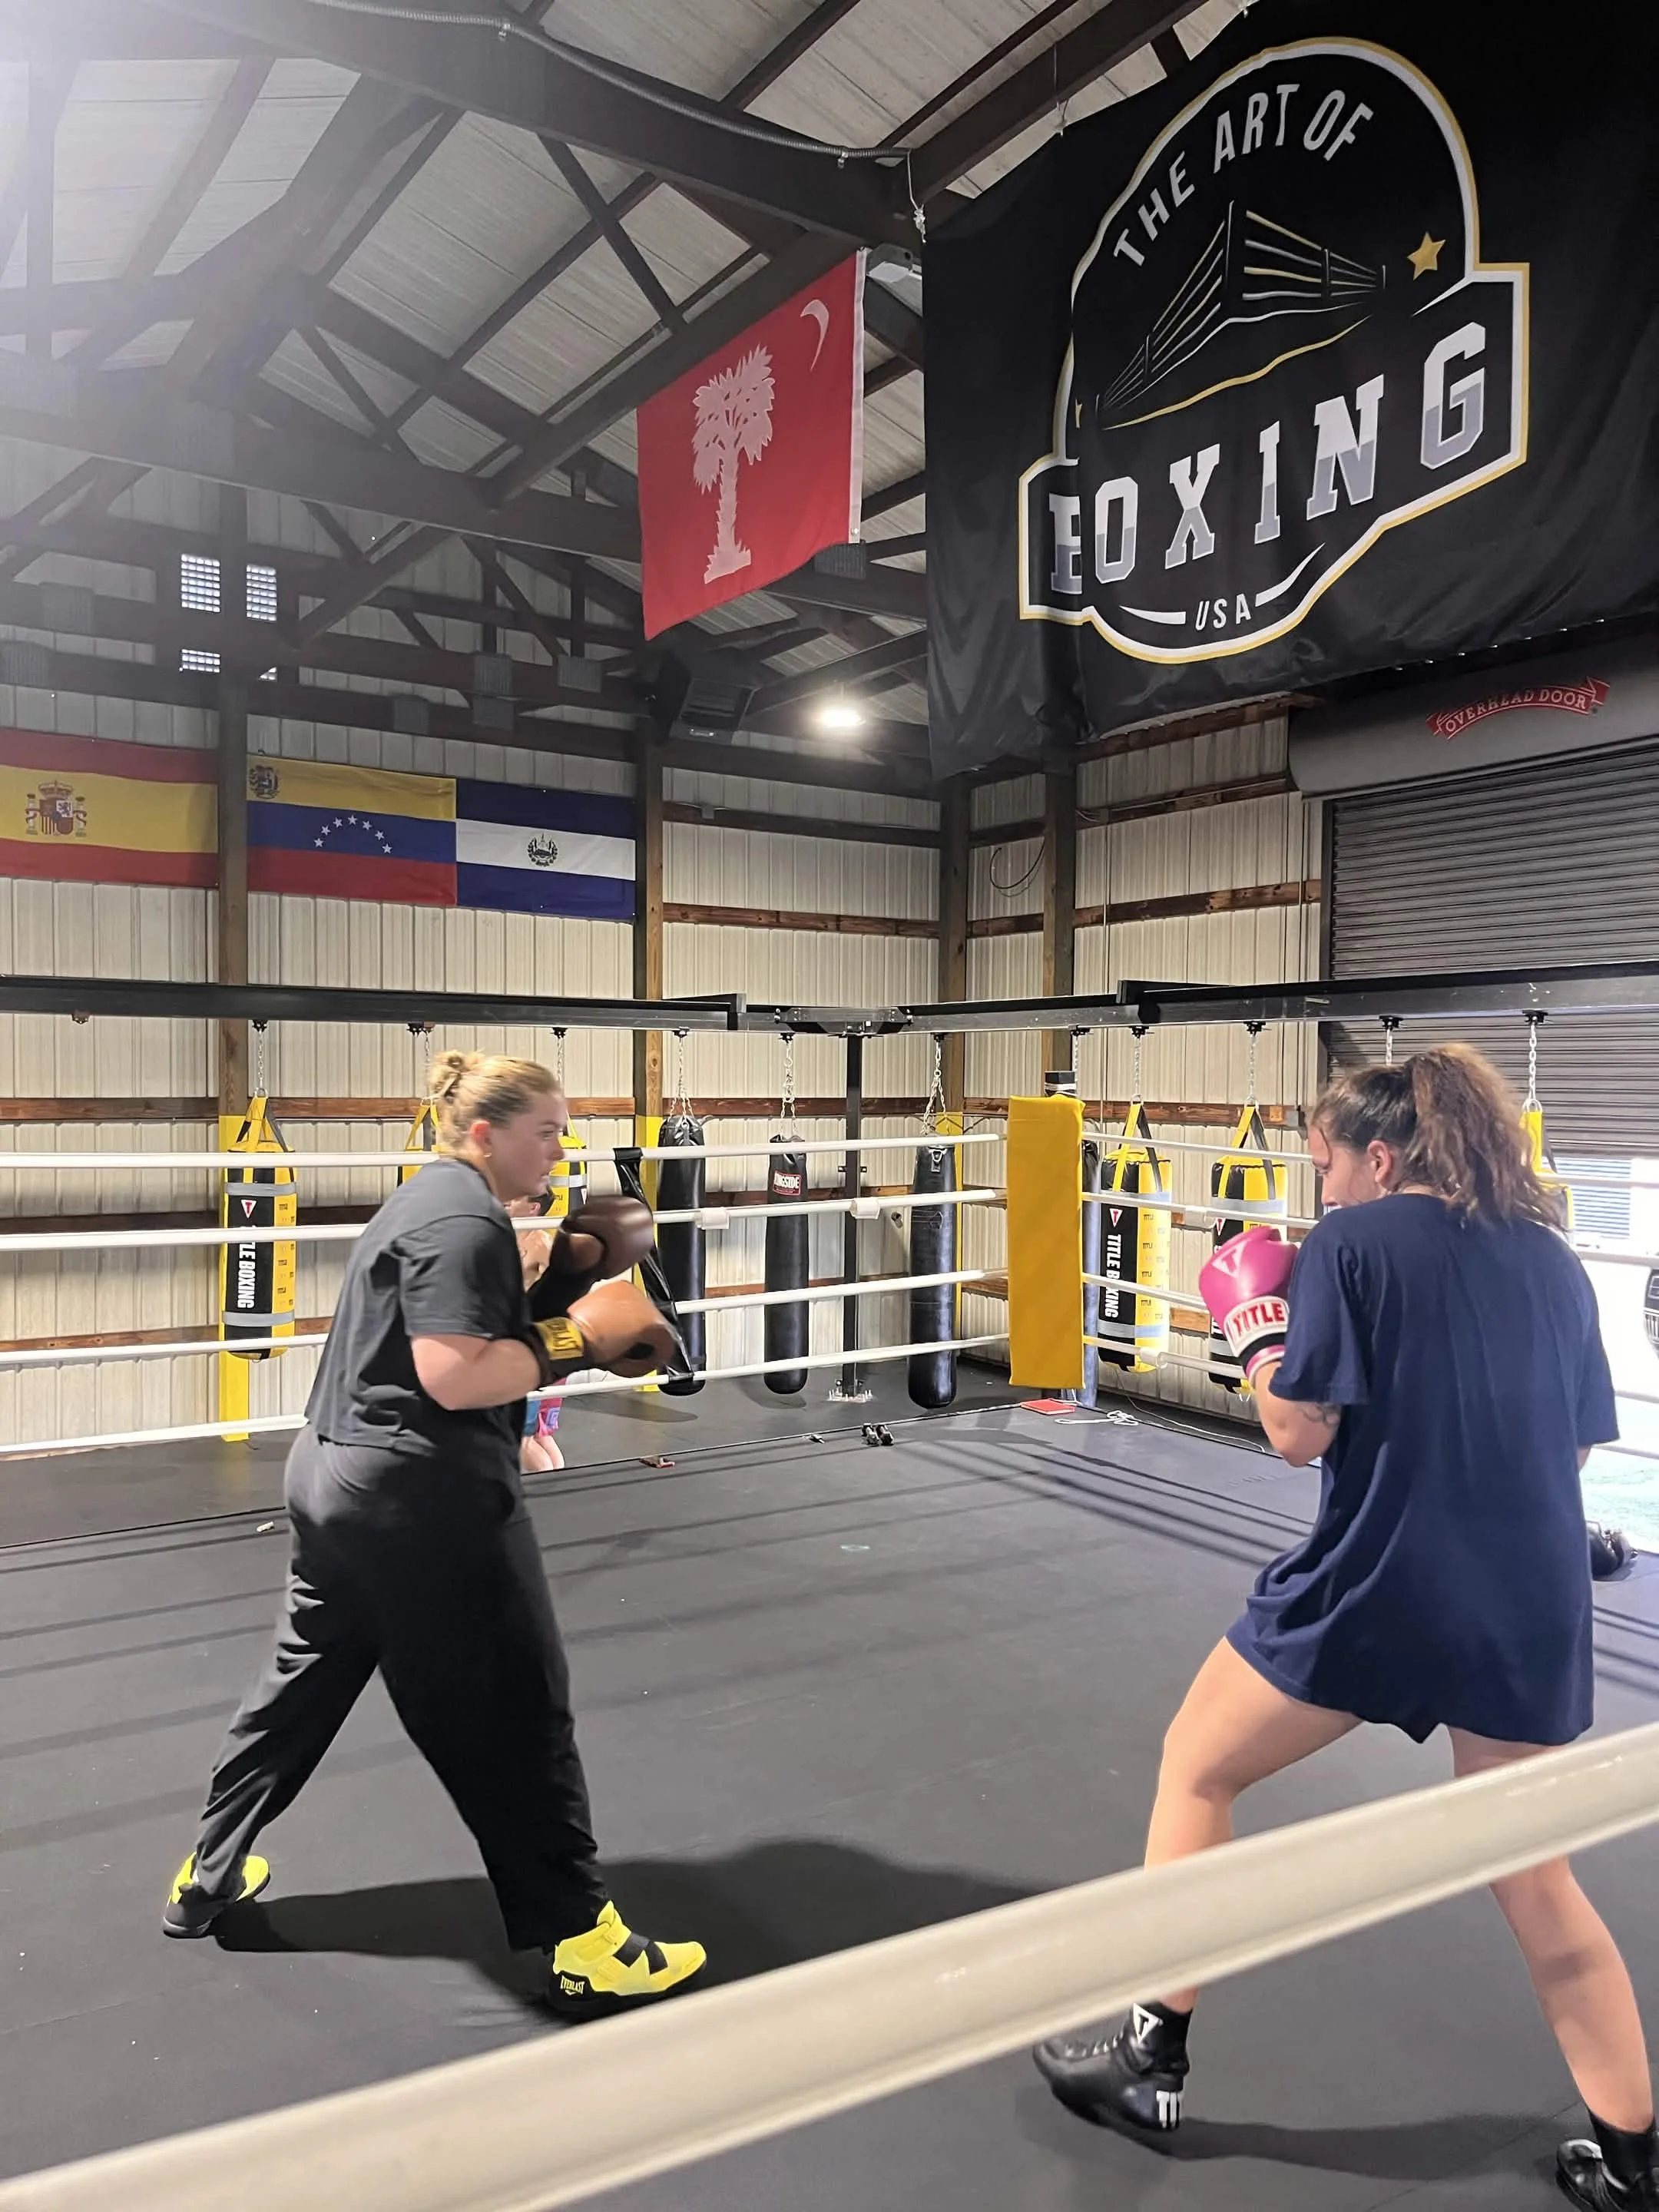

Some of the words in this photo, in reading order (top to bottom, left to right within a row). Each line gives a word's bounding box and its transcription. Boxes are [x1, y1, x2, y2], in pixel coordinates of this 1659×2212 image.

[1113, 151, 1197, 267] THE
[1213, 84, 1300, 174] ART
[1303, 90, 1374, 161] OF
[1195, 593, 1252, 631] USA
[1445, 690, 1535, 733] OVERHEAD
[1538, 688, 1587, 710] DOOR
[1106, 1233, 1121, 1267] TITLE
[237, 1260, 256, 1309] BOXING
[1105, 1269, 1121, 1318] BXING
